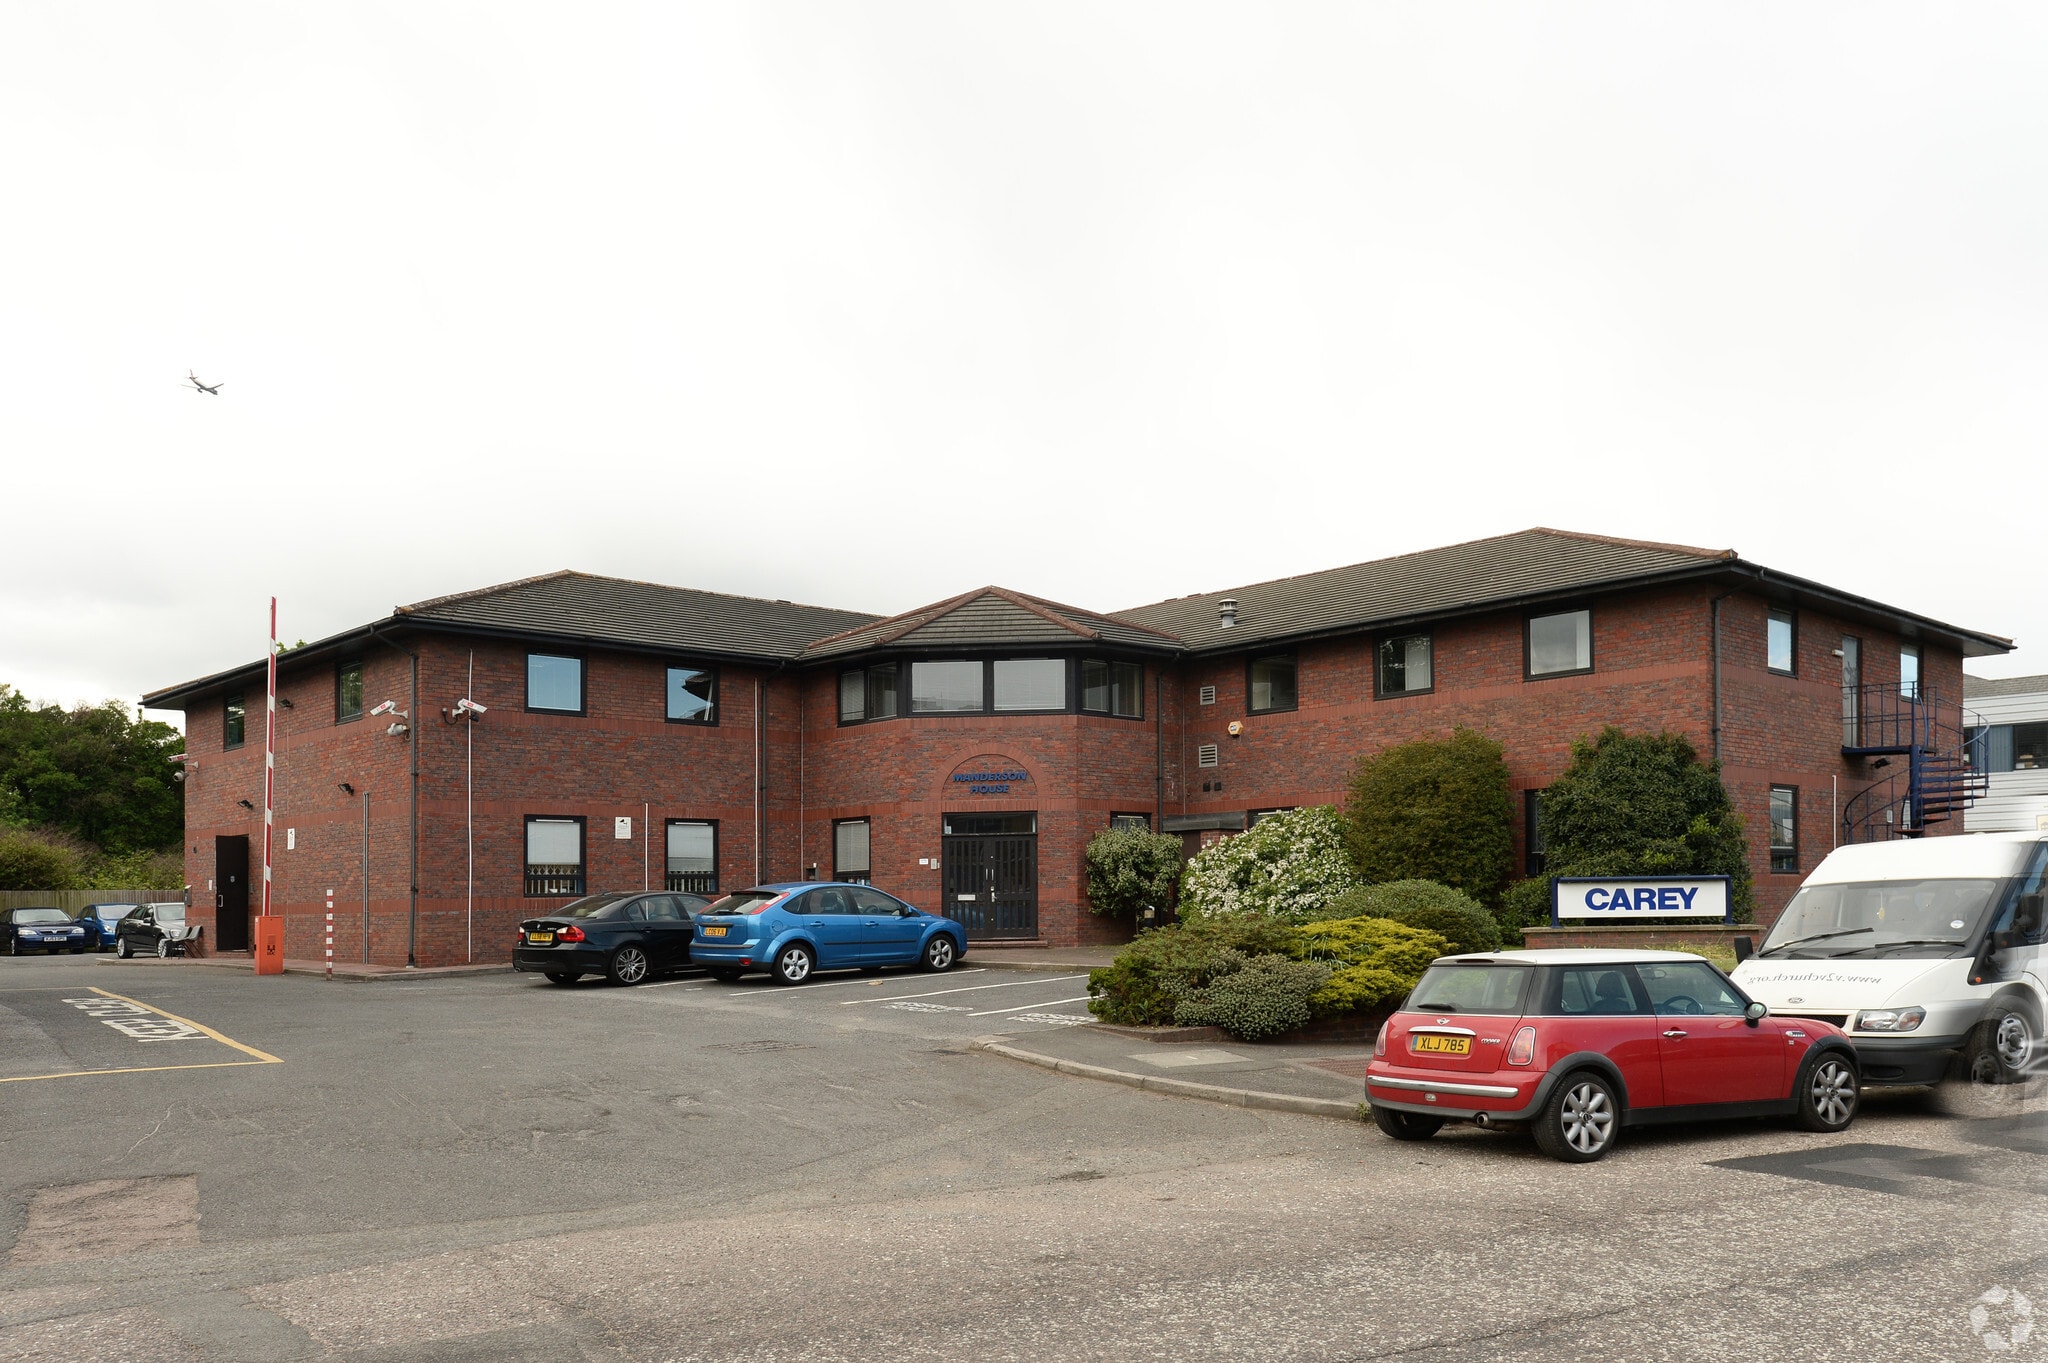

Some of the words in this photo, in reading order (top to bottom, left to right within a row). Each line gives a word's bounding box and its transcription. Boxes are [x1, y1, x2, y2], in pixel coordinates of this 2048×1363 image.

[953, 772, 1027, 782] MANDERSON
[970, 784, 1010, 793] HOUSE
[1585, 887, 1699, 911] CAREY
[61, 998, 152, 1016] CLEAR
[101, 1018, 210, 1042] KEEP
[1420, 1037, 1442, 1050] XLJ
[1444, 1038, 1465, 1051] 785
